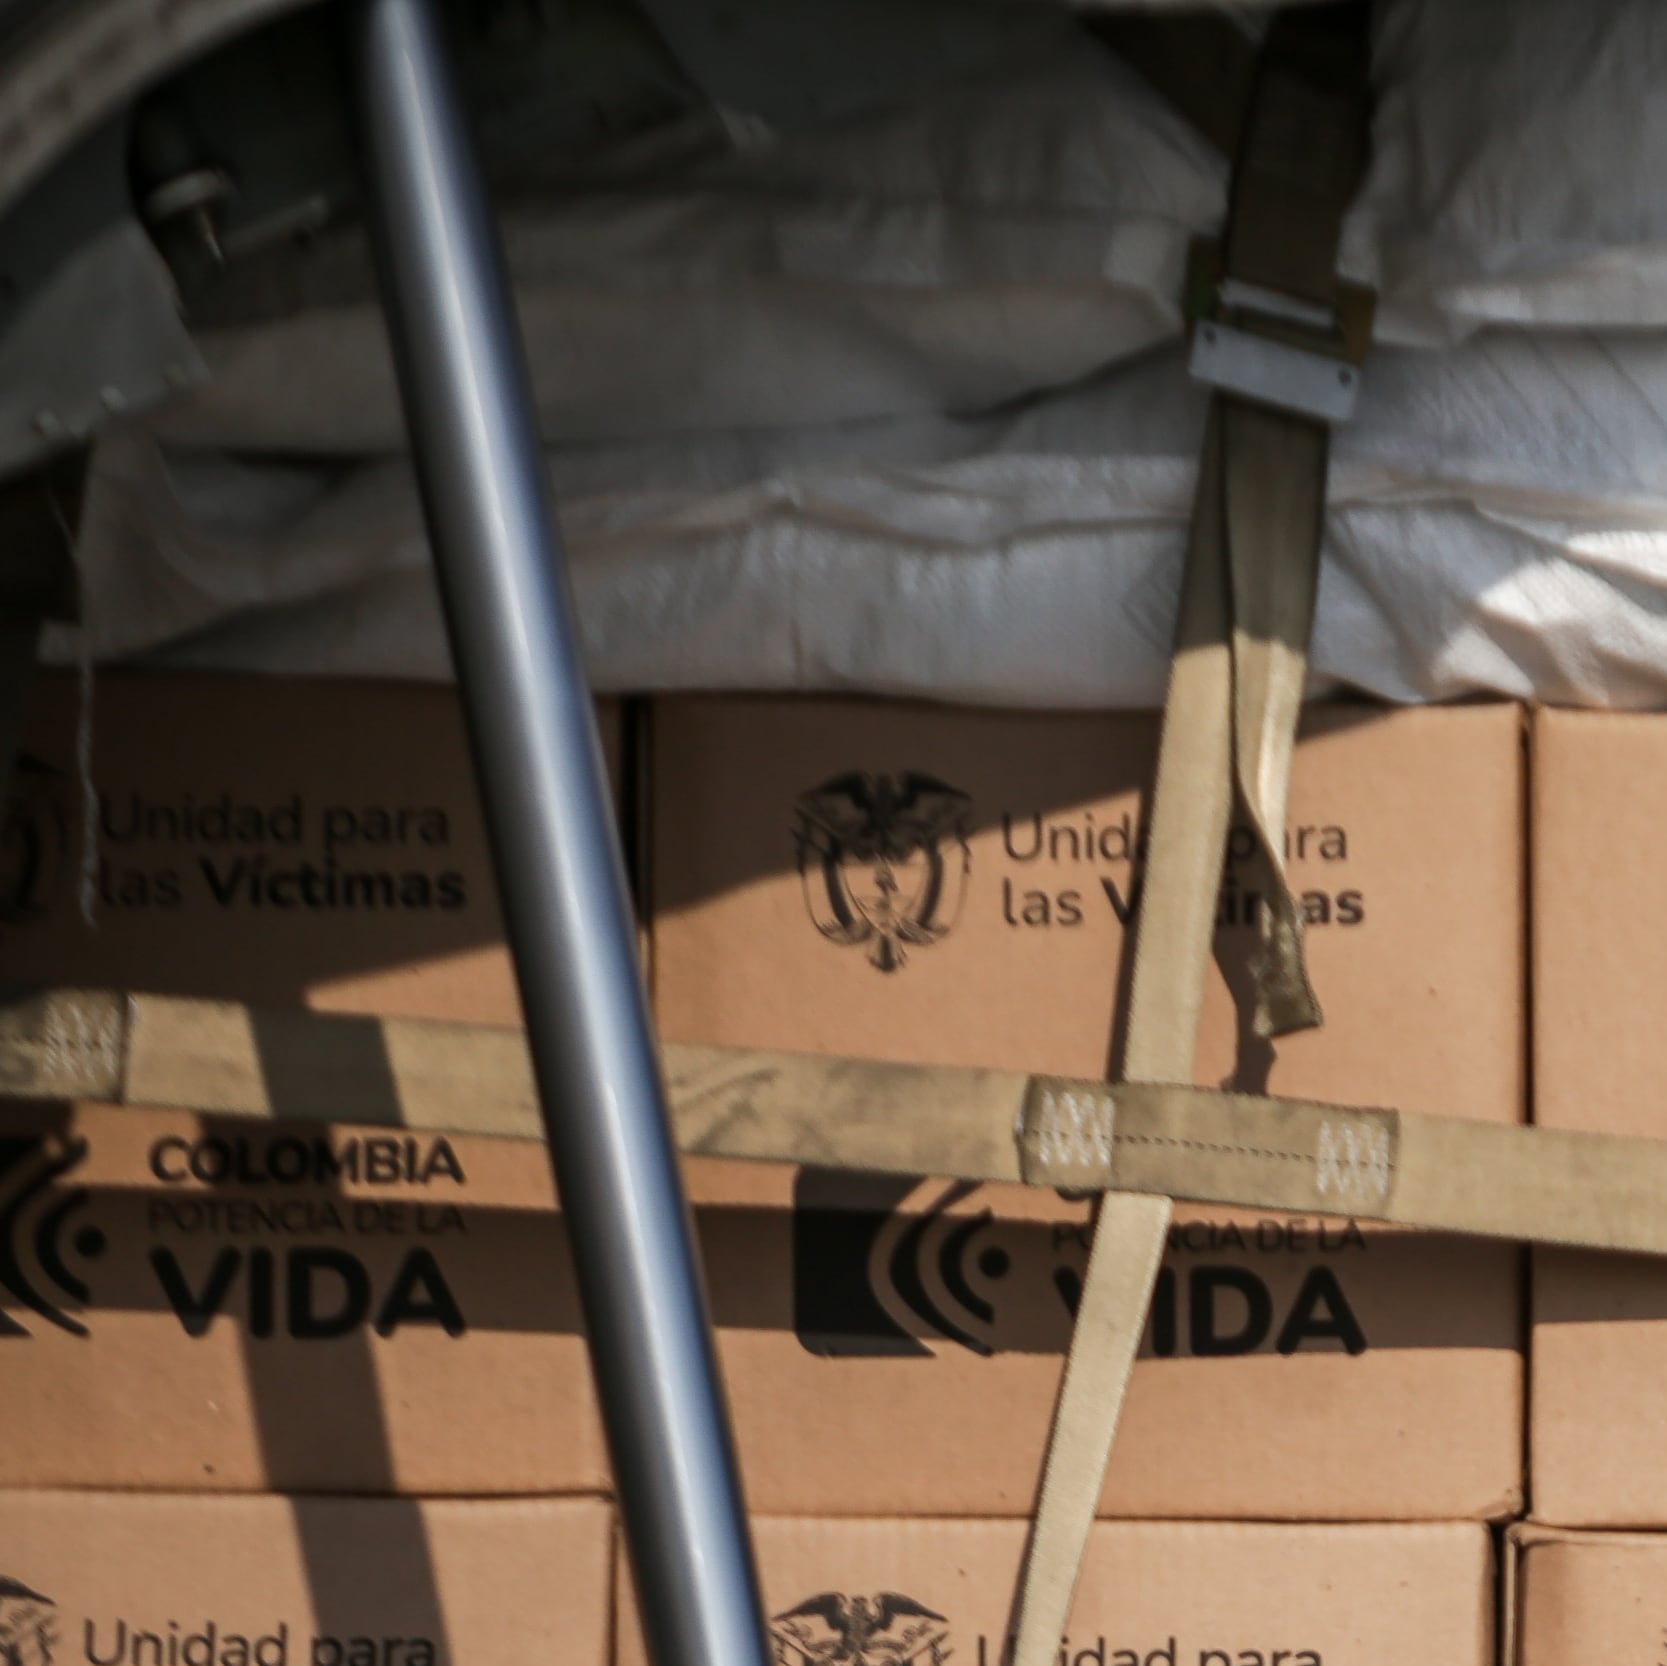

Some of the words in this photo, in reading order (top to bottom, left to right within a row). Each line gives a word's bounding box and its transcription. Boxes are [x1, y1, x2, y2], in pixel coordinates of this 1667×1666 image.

[102, 794, 303, 845] Unidad
[322, 806, 450, 860] para
[1001, 810, 1148, 864] Unid
[100, 858, 184, 908] las
[200, 857, 467, 910] Víctimas
[1001, 874, 1085, 928] las
[149, 1134, 467, 1186] COLOMBIA
[147, 1199, 347, 1236] POTENCIA
[356, 1201, 407, 1236] DE
[417, 1202, 468, 1236] LA
[1257, 1218, 1308, 1254] DE
[1318, 1218, 1367, 1253] LA
[148, 1245, 469, 1340] VIDA
